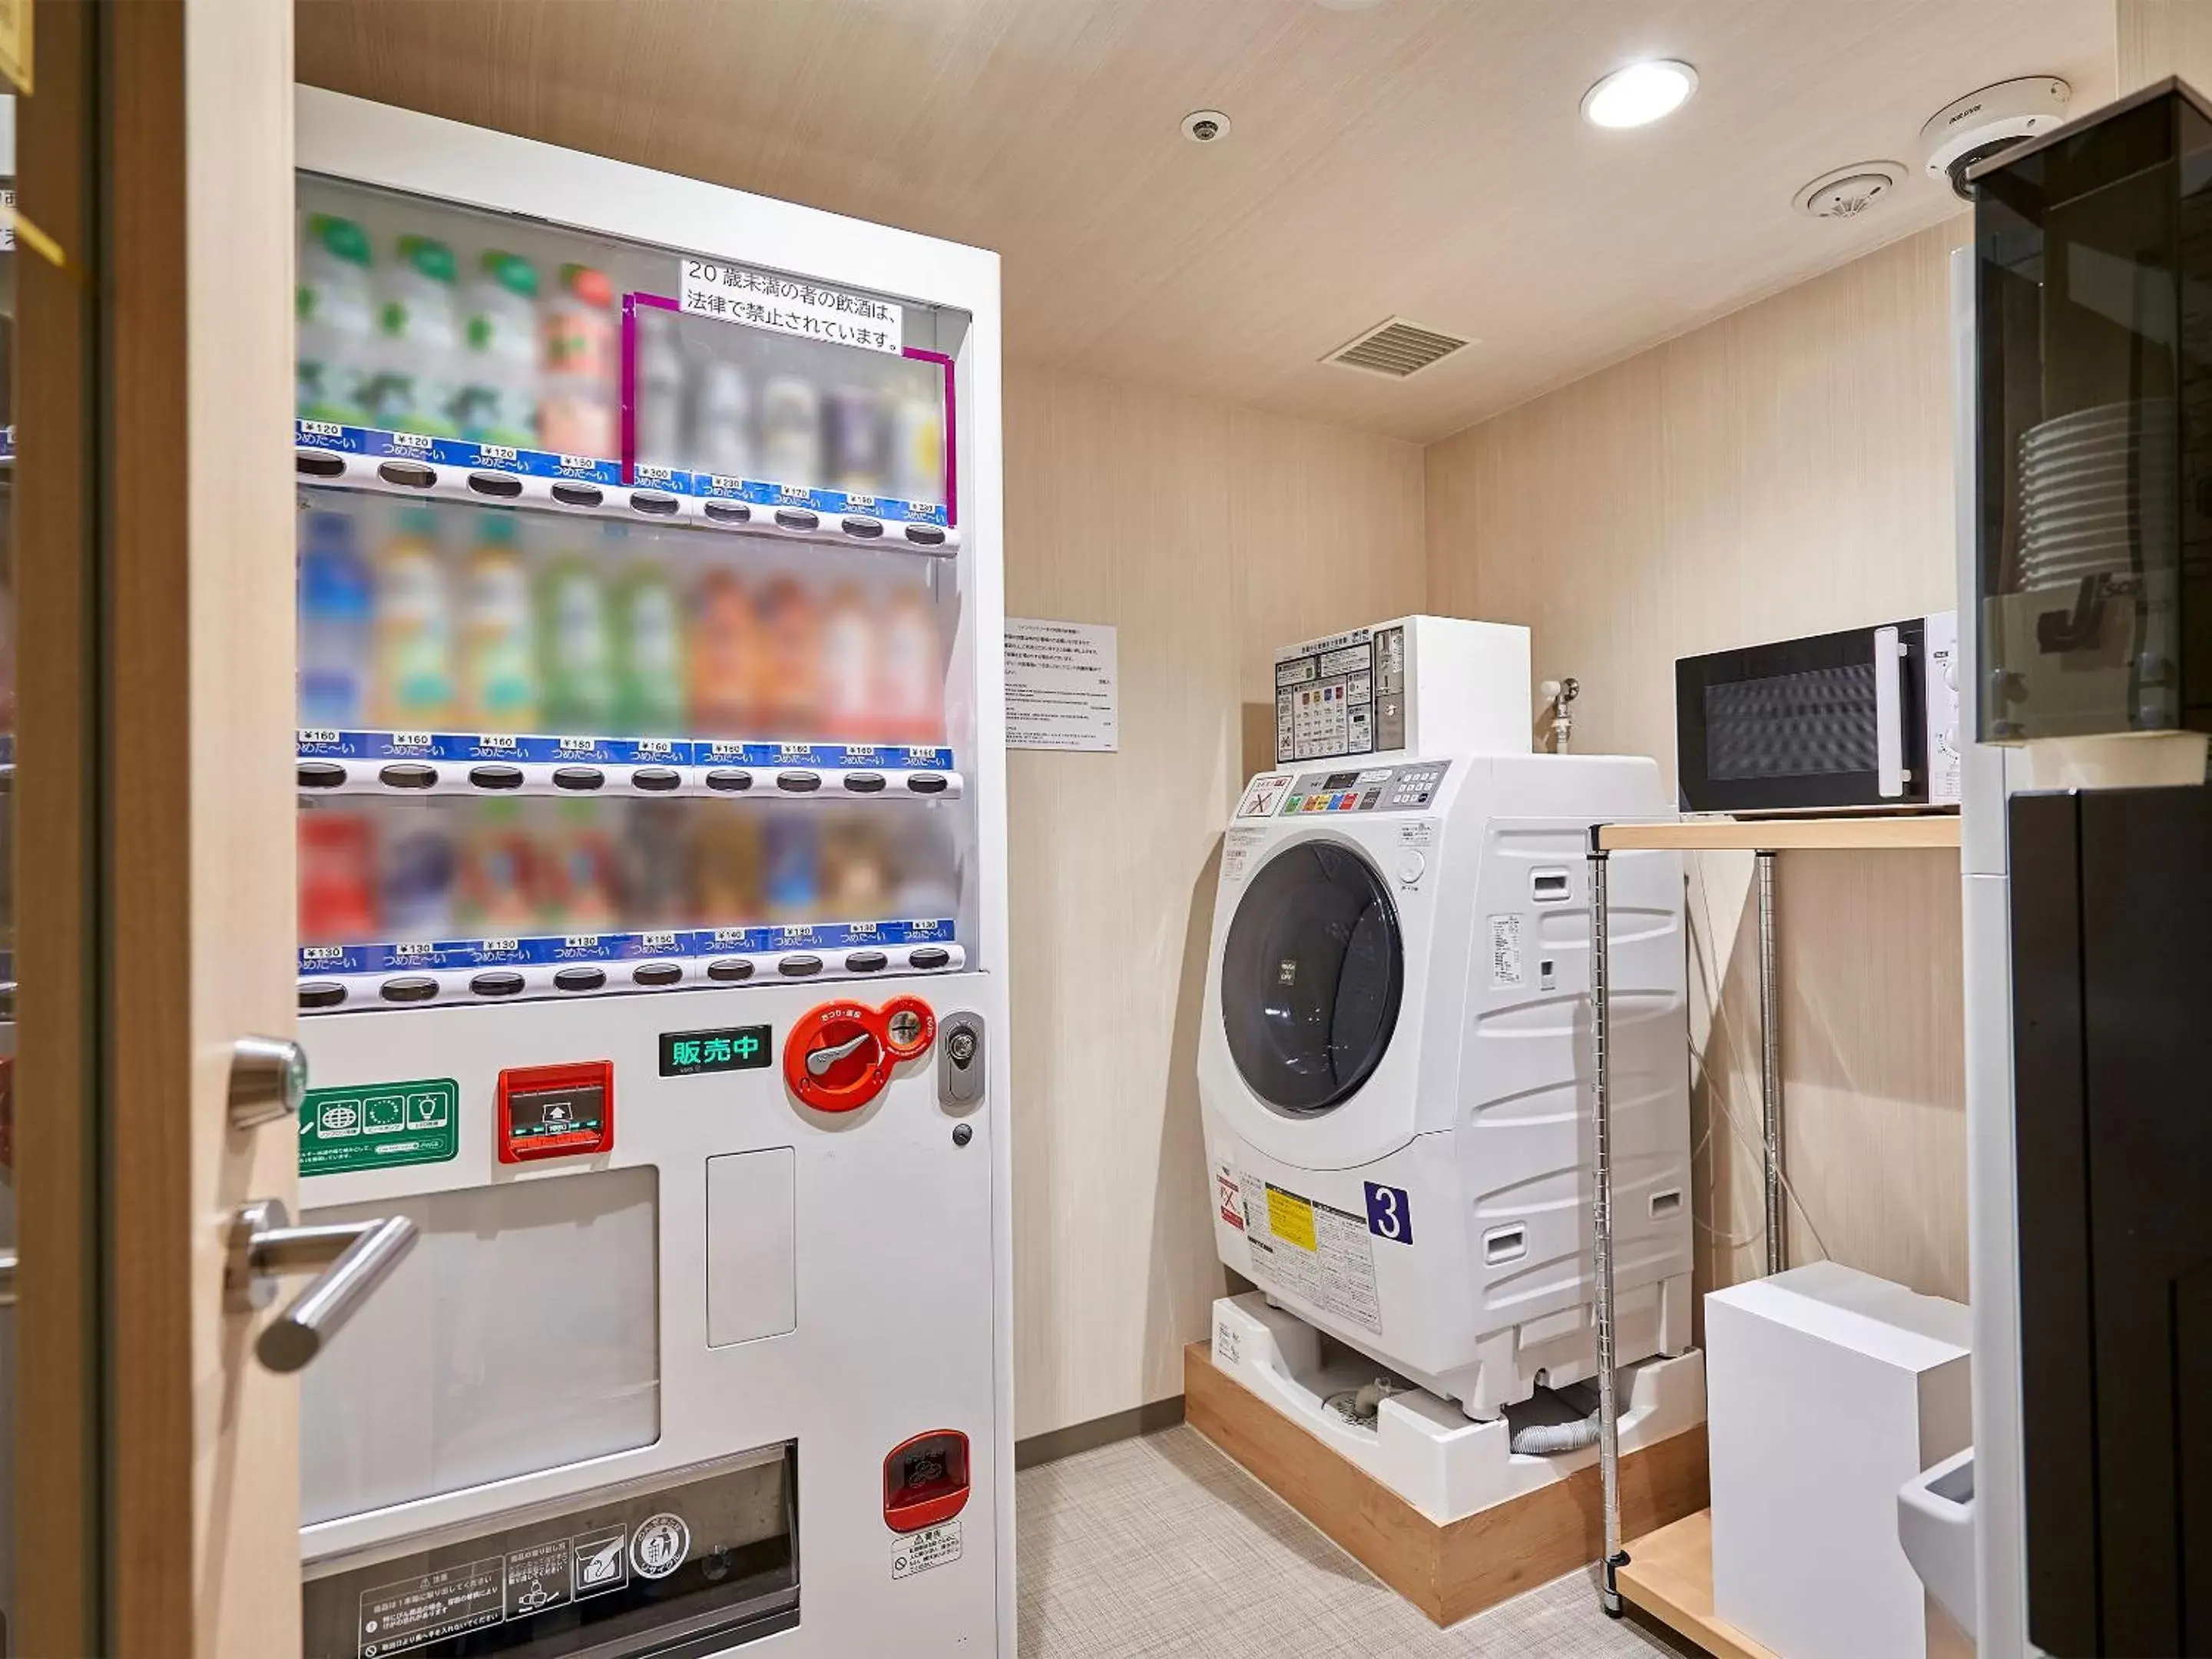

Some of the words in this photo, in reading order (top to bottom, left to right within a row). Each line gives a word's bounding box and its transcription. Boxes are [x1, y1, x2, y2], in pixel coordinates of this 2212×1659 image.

[689, 260, 717, 283] 20
[687, 289, 897, 351] 法律で禁止されています。
[306, 422, 339, 434] ¥120
[397, 435, 429, 447] ¥120
[485, 446, 514, 459] ¥120
[304, 730, 336, 741] ¥160
[397, 734, 429, 744] ¥160
[400, 944, 430, 953] ¥130
[487, 940, 516, 949] ¥130
[307, 948, 340, 958] ¥130
[672, 1035, 759, 1066] 販売中
[1376, 1187, 1400, 1239] 3
